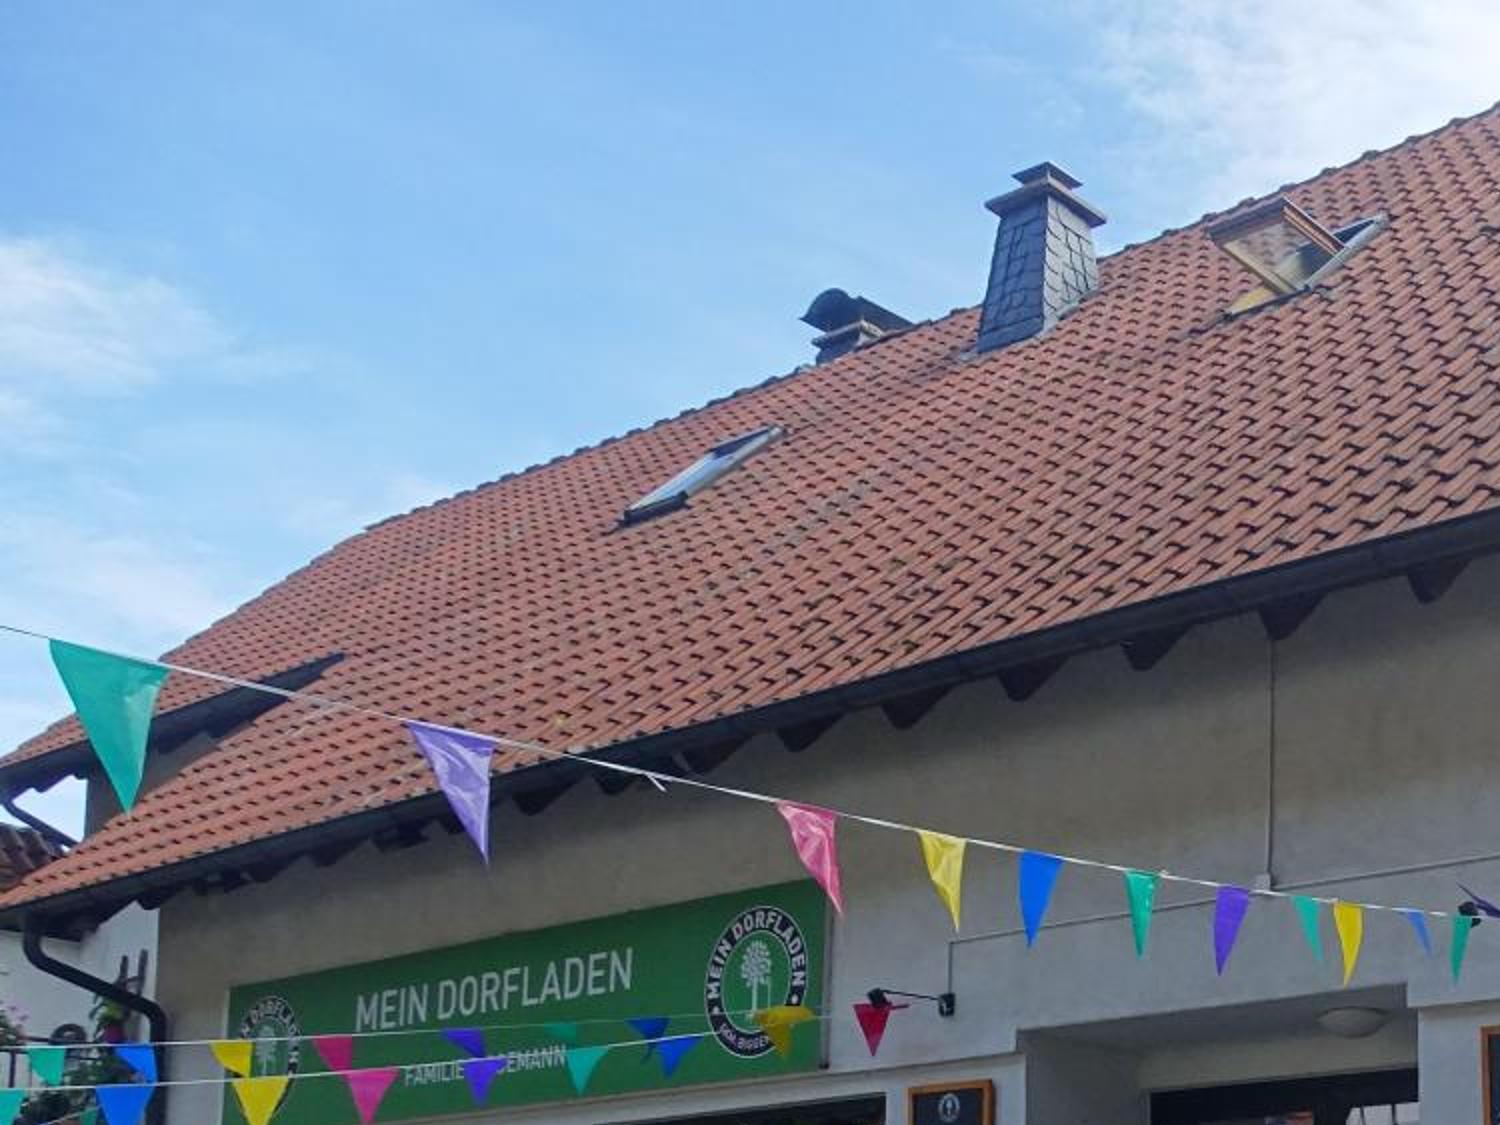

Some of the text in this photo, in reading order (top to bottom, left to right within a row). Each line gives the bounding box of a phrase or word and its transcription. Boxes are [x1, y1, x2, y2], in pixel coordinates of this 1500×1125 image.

[355, 947, 633, 1033] MEIN DORFLADEN
[707, 911, 805, 999] MEIN DORFLADEN
[405, 1060, 464, 1087] FAMILIE
